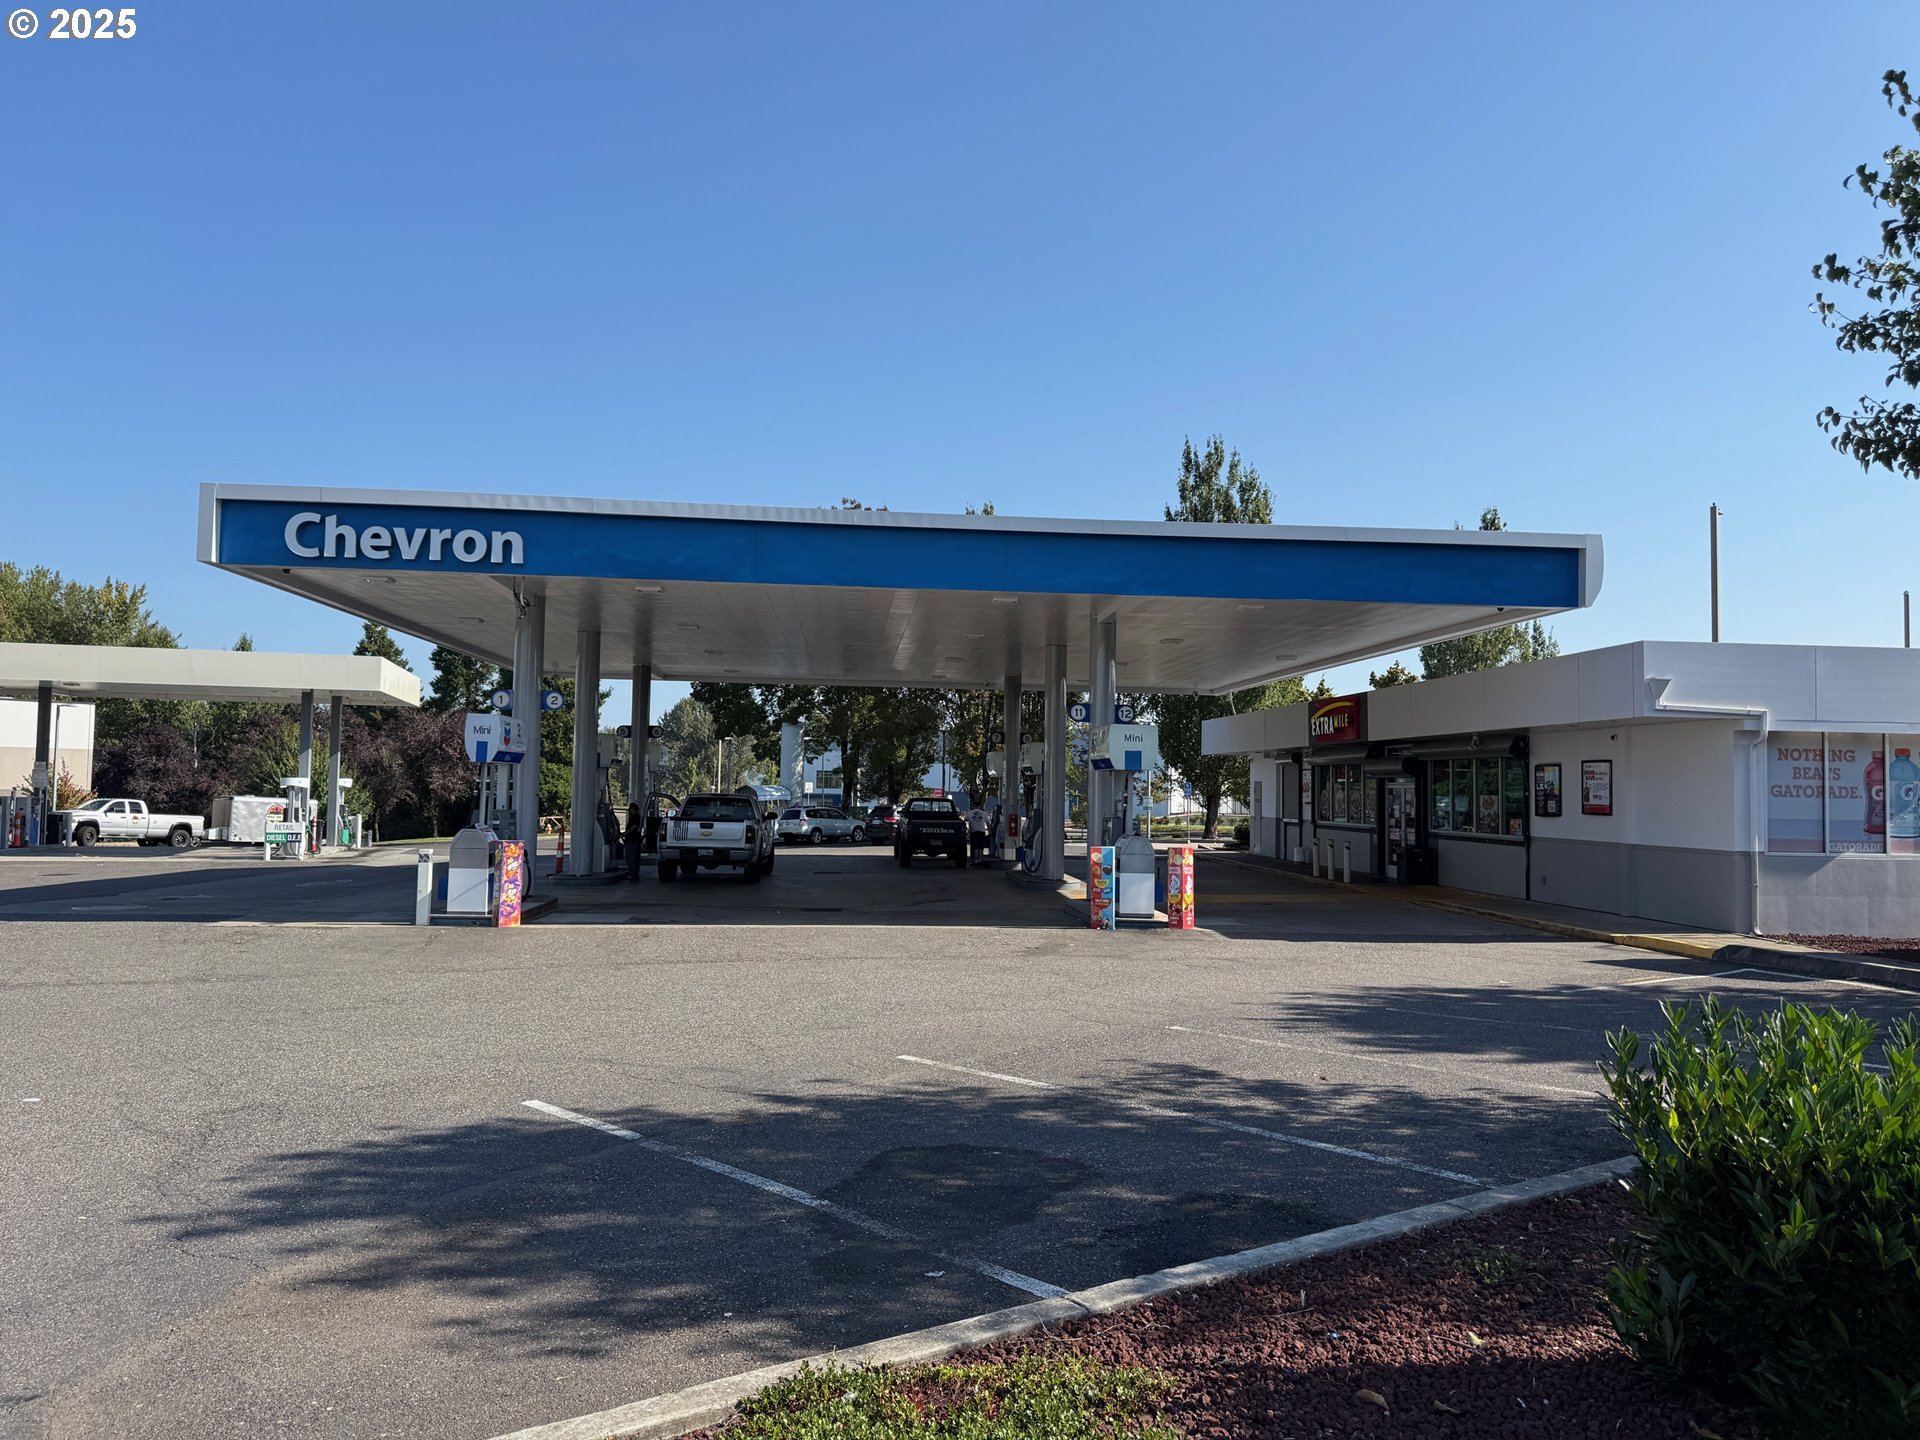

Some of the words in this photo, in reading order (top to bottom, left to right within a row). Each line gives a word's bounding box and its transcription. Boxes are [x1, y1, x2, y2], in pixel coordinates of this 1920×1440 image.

[284, 512, 525, 565] Chevron
[550, 695, 559, 705] 2
[1074, 707, 1083, 717] 11
[1120, 709, 1131, 719] 12
[473, 725, 492, 735] Mini
[1124, 733, 1144, 743] Mini
[1776, 748, 1856, 763] NOTHNG
[1792, 766, 1841, 781] BEAS
[1828, 842, 1884, 853] GATORADE
